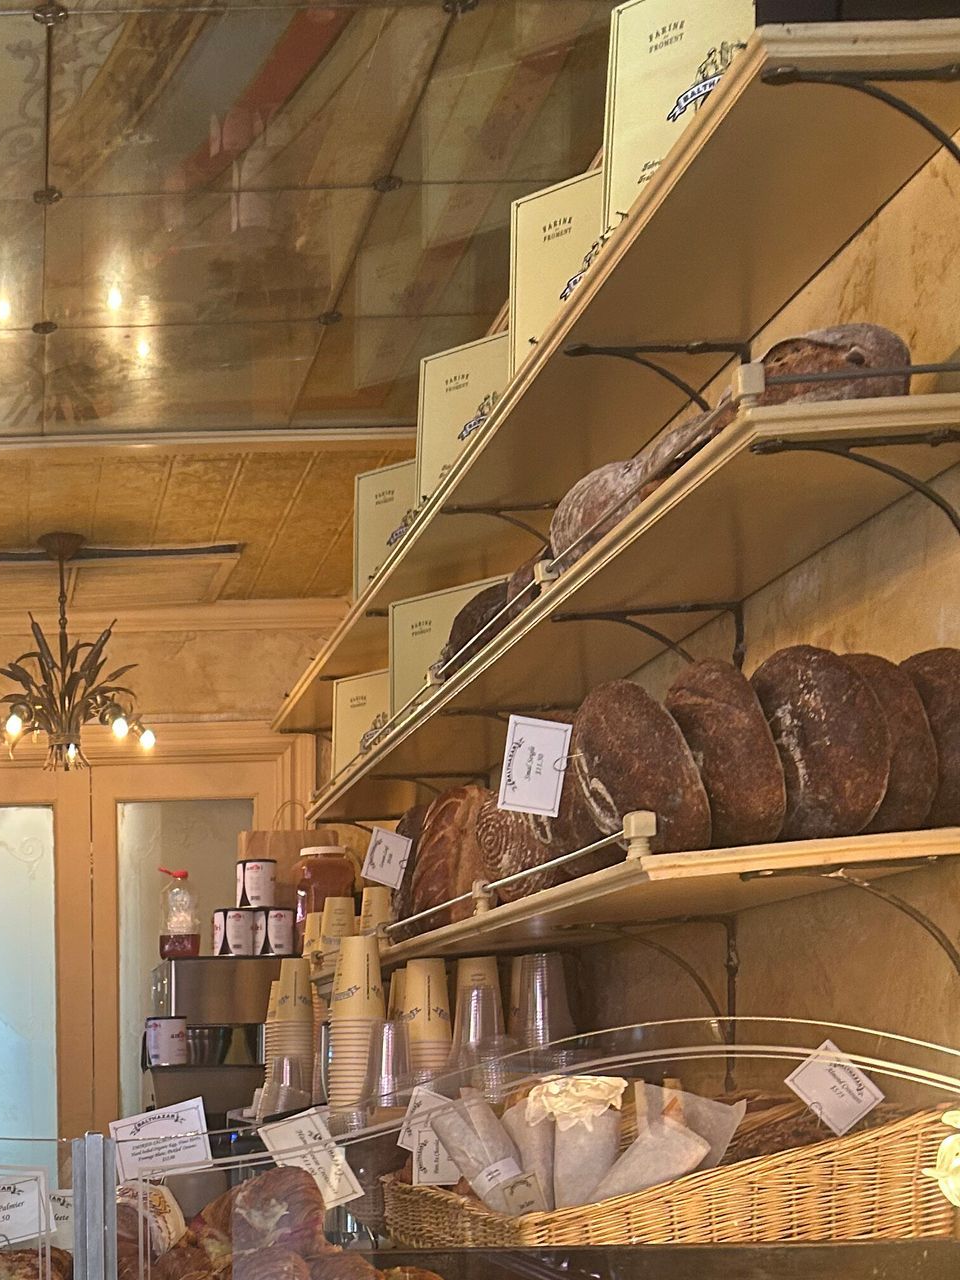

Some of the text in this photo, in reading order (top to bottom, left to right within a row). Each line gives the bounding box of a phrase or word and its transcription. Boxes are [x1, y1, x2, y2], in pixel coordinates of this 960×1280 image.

[649, 32, 685, 54] FROMENT
[507, 744, 518, 783] BALTHAZAR
[137, 1114, 175, 1127] BALTHAZAR
